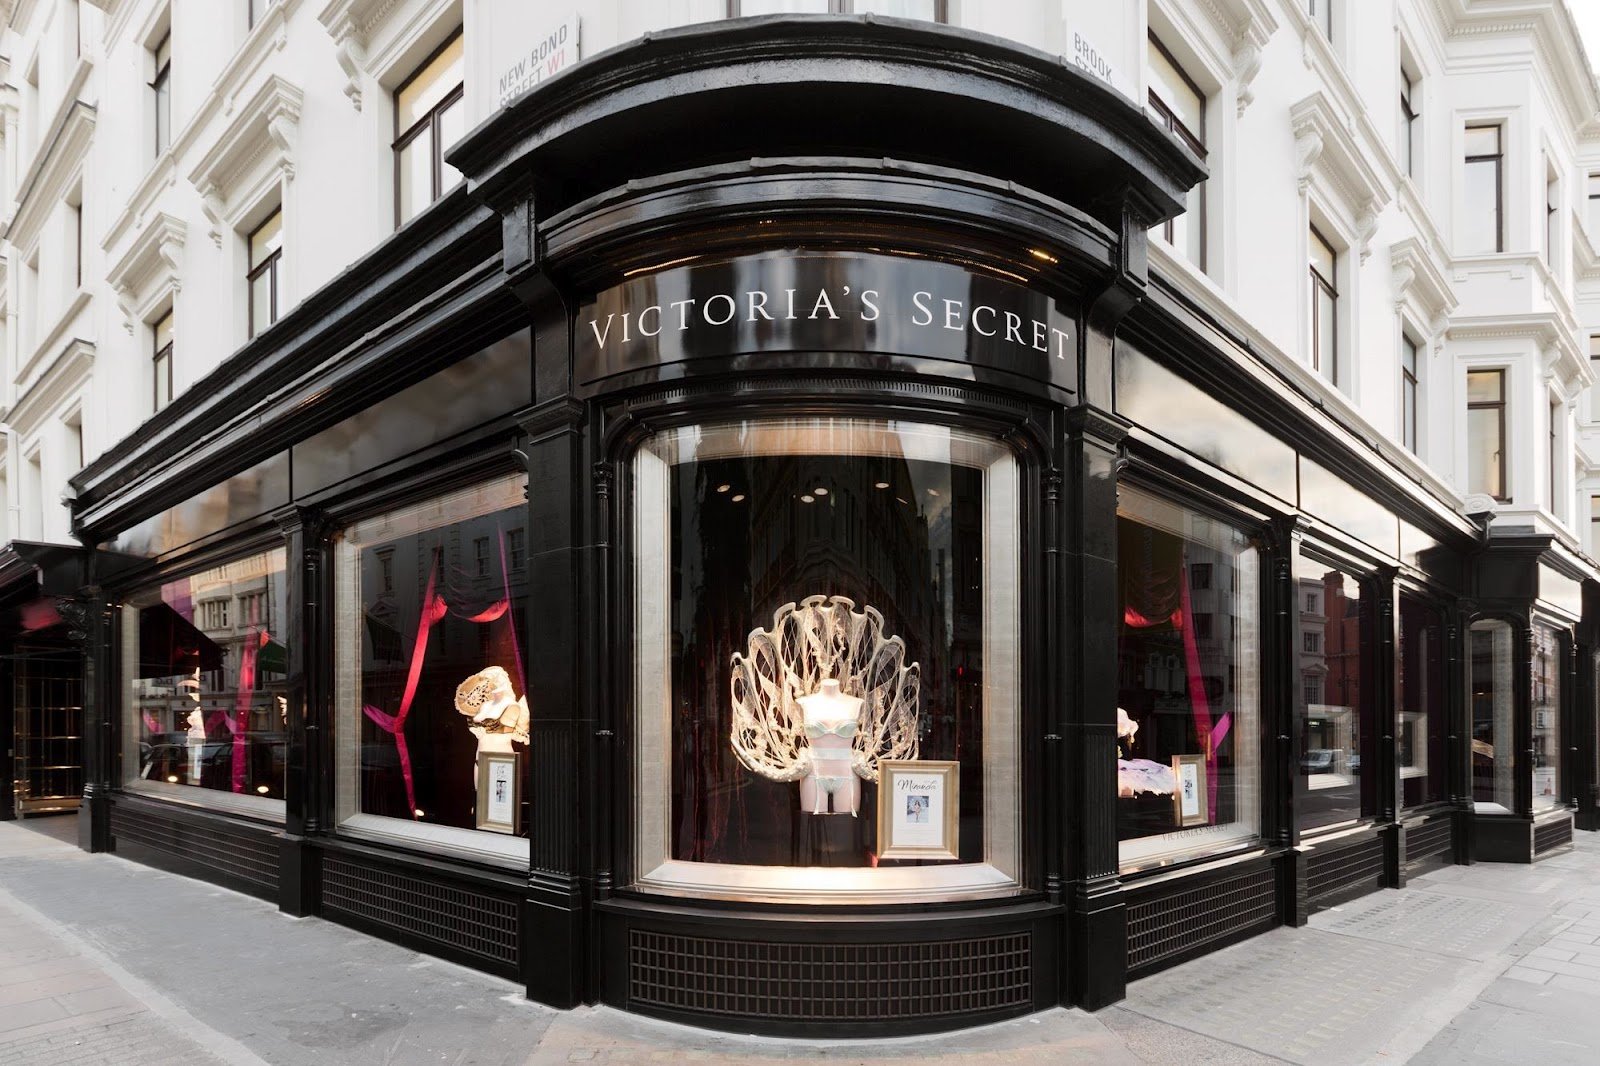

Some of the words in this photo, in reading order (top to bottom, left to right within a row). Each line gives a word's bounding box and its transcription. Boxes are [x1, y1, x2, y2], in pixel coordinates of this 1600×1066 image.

[500, 57, 526, 95] NEW
[531, 23, 567, 67] BOND
[547, 48, 565, 75] W1
[1074, 31, 1113, 84] BROOK
[589, 286, 880, 350] VICTORIA'S
[912, 291, 1069, 360] SECRET
